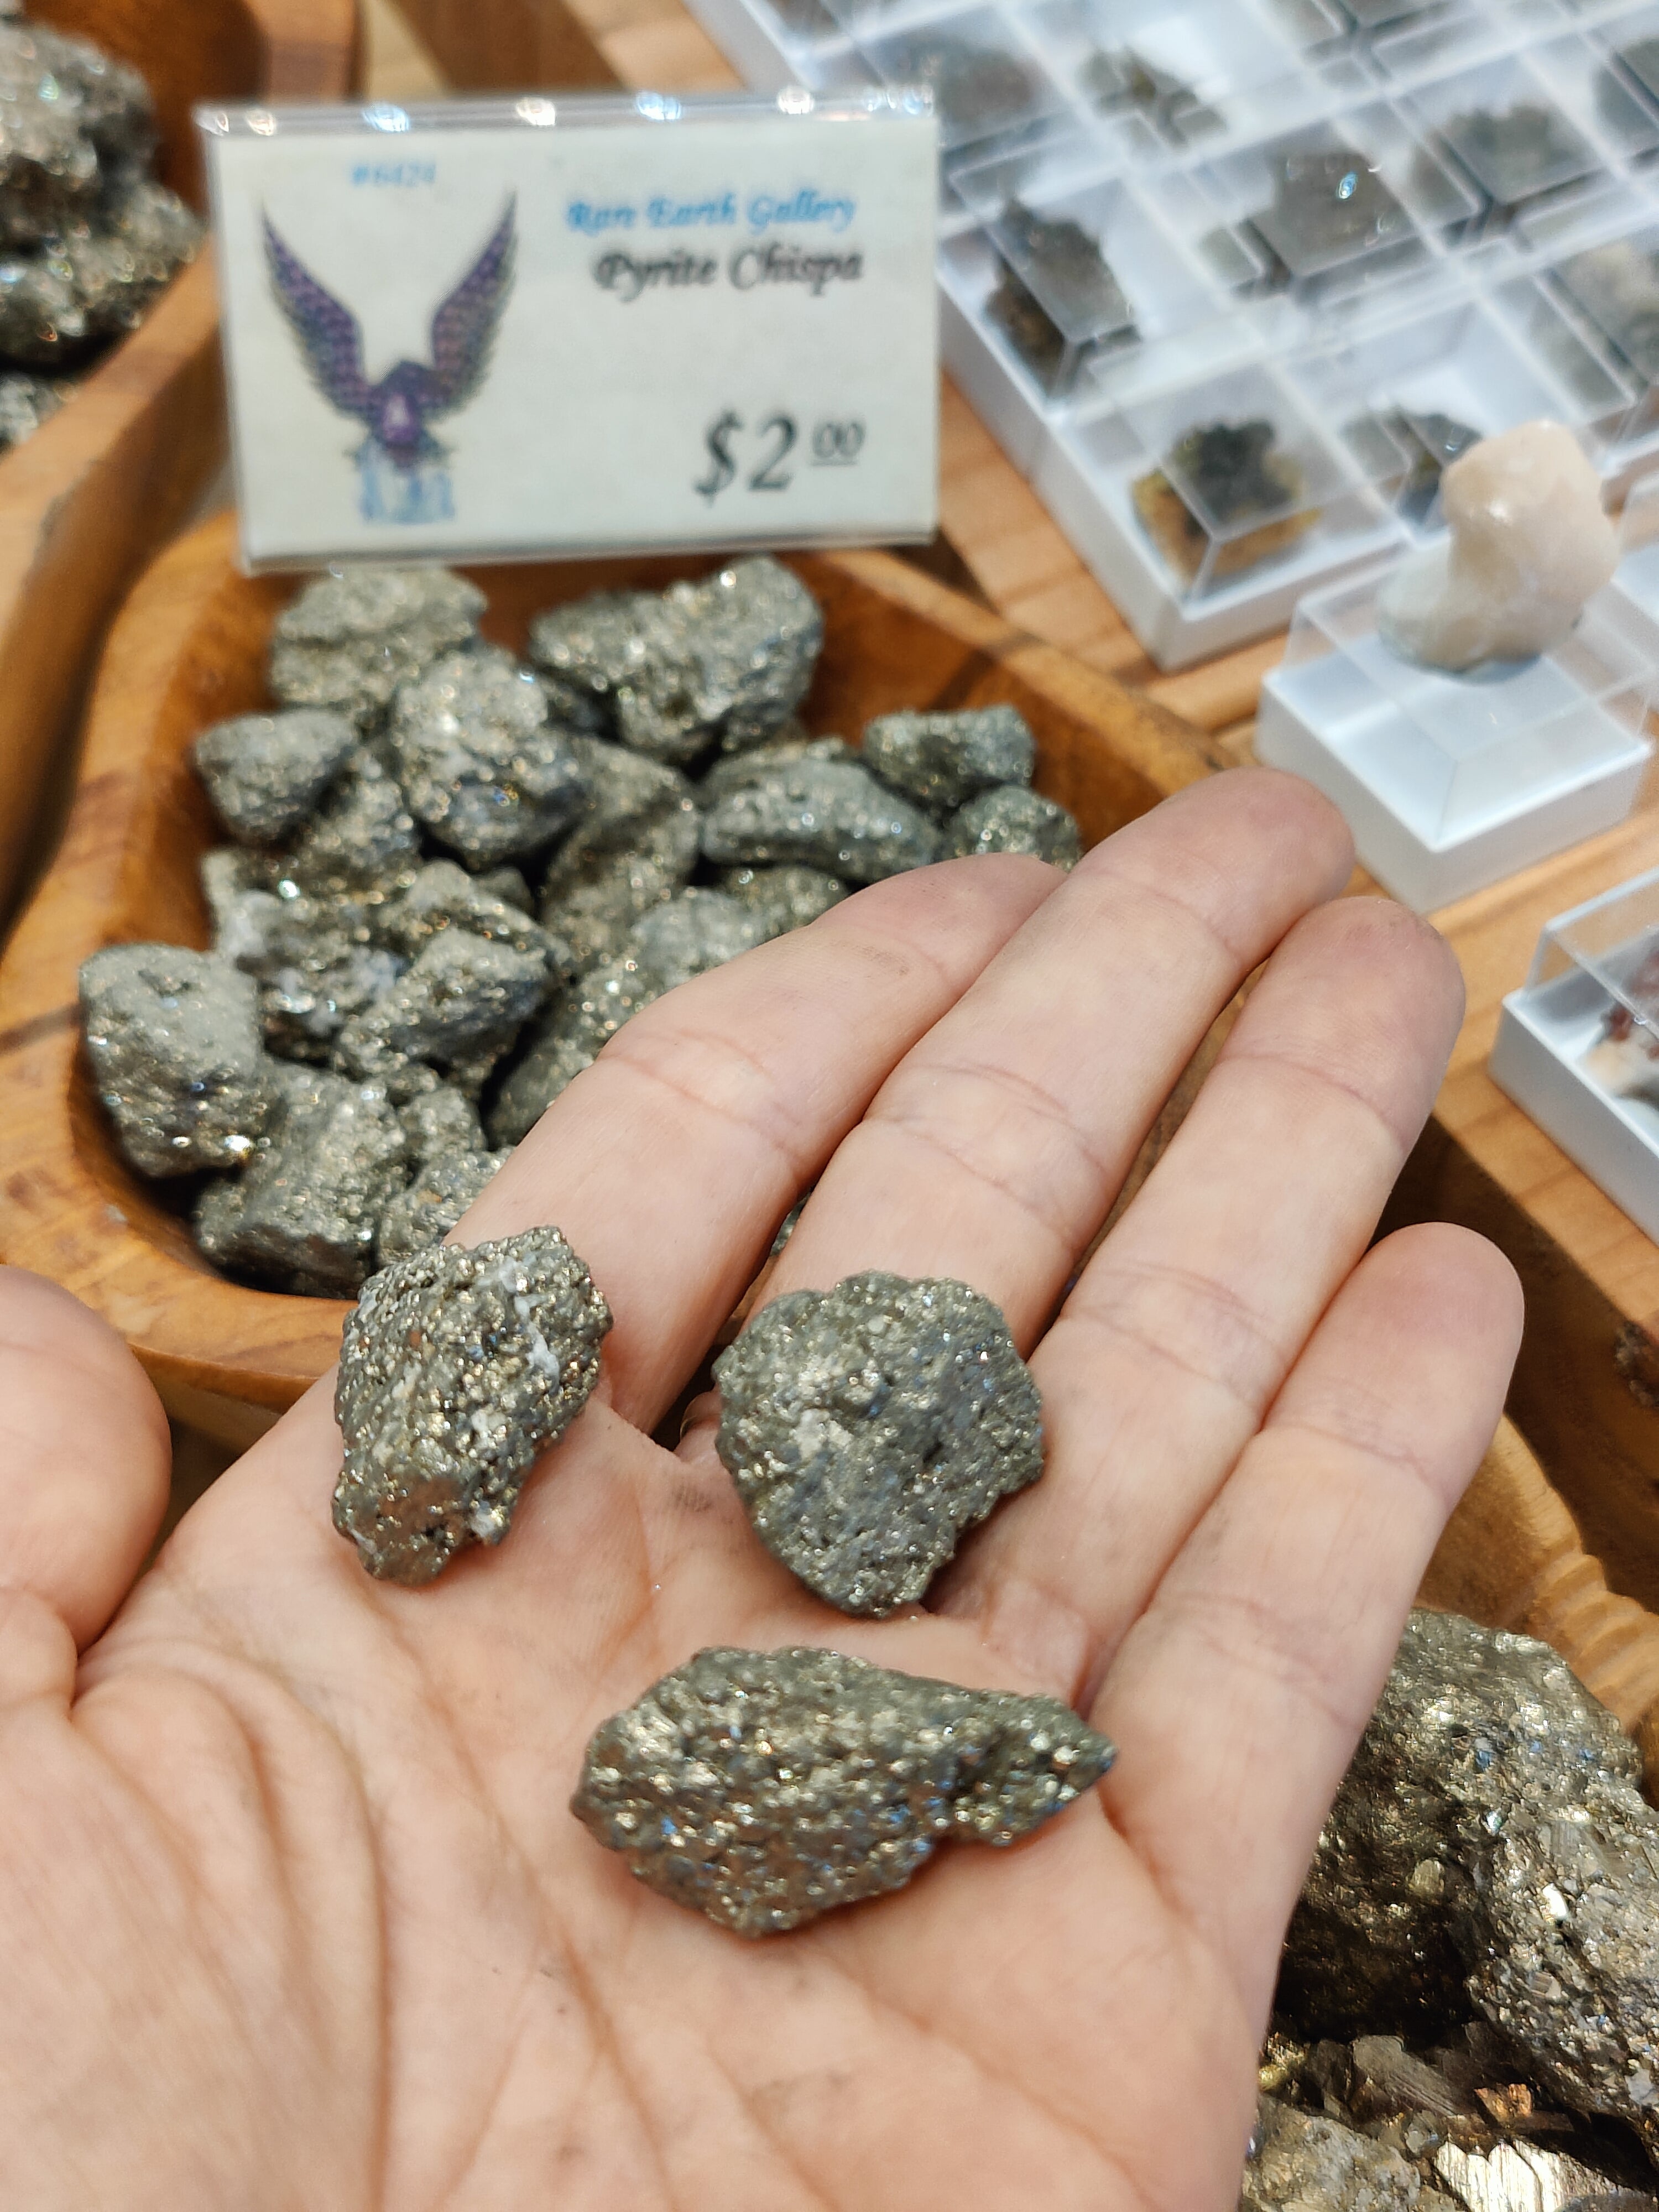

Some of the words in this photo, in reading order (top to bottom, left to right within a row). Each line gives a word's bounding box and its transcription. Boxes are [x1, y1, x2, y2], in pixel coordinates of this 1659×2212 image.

[566, 199, 636, 237] Rare
[647, 194, 738, 228] Earth
[747, 188, 856, 234] Gallery
[593, 249, 718, 302] Pyrite
[727, 241, 864, 299] Chispa
